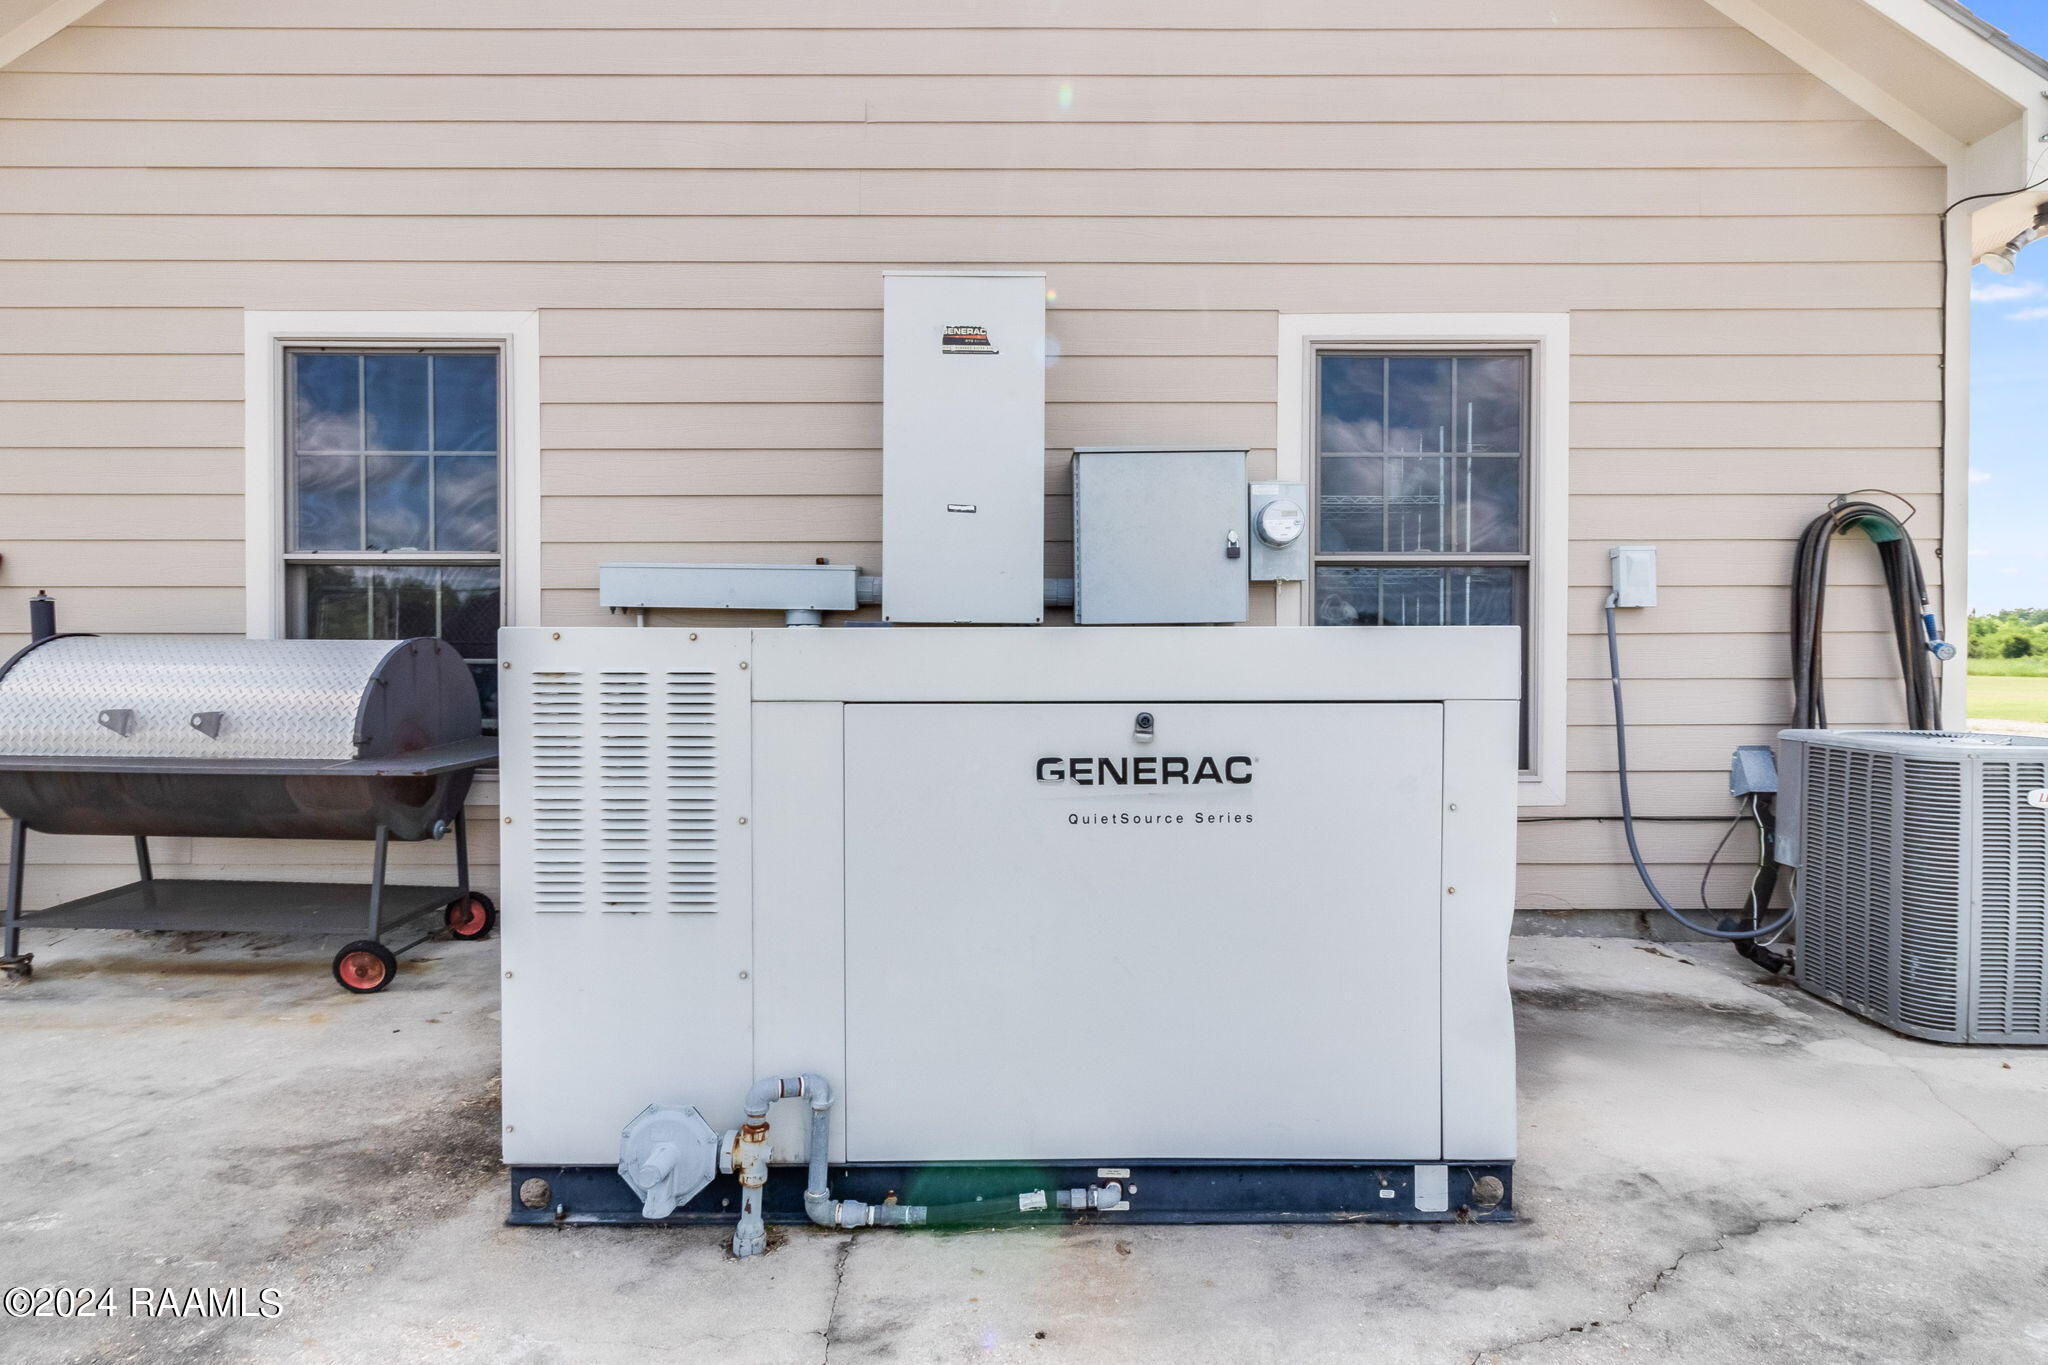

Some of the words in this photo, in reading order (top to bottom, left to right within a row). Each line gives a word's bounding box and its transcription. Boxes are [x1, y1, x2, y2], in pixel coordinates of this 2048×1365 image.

[1036, 756, 1253, 785] GENERAC
[1068, 813, 1184, 825] QuietSource
[1195, 812, 1253, 824] Series
